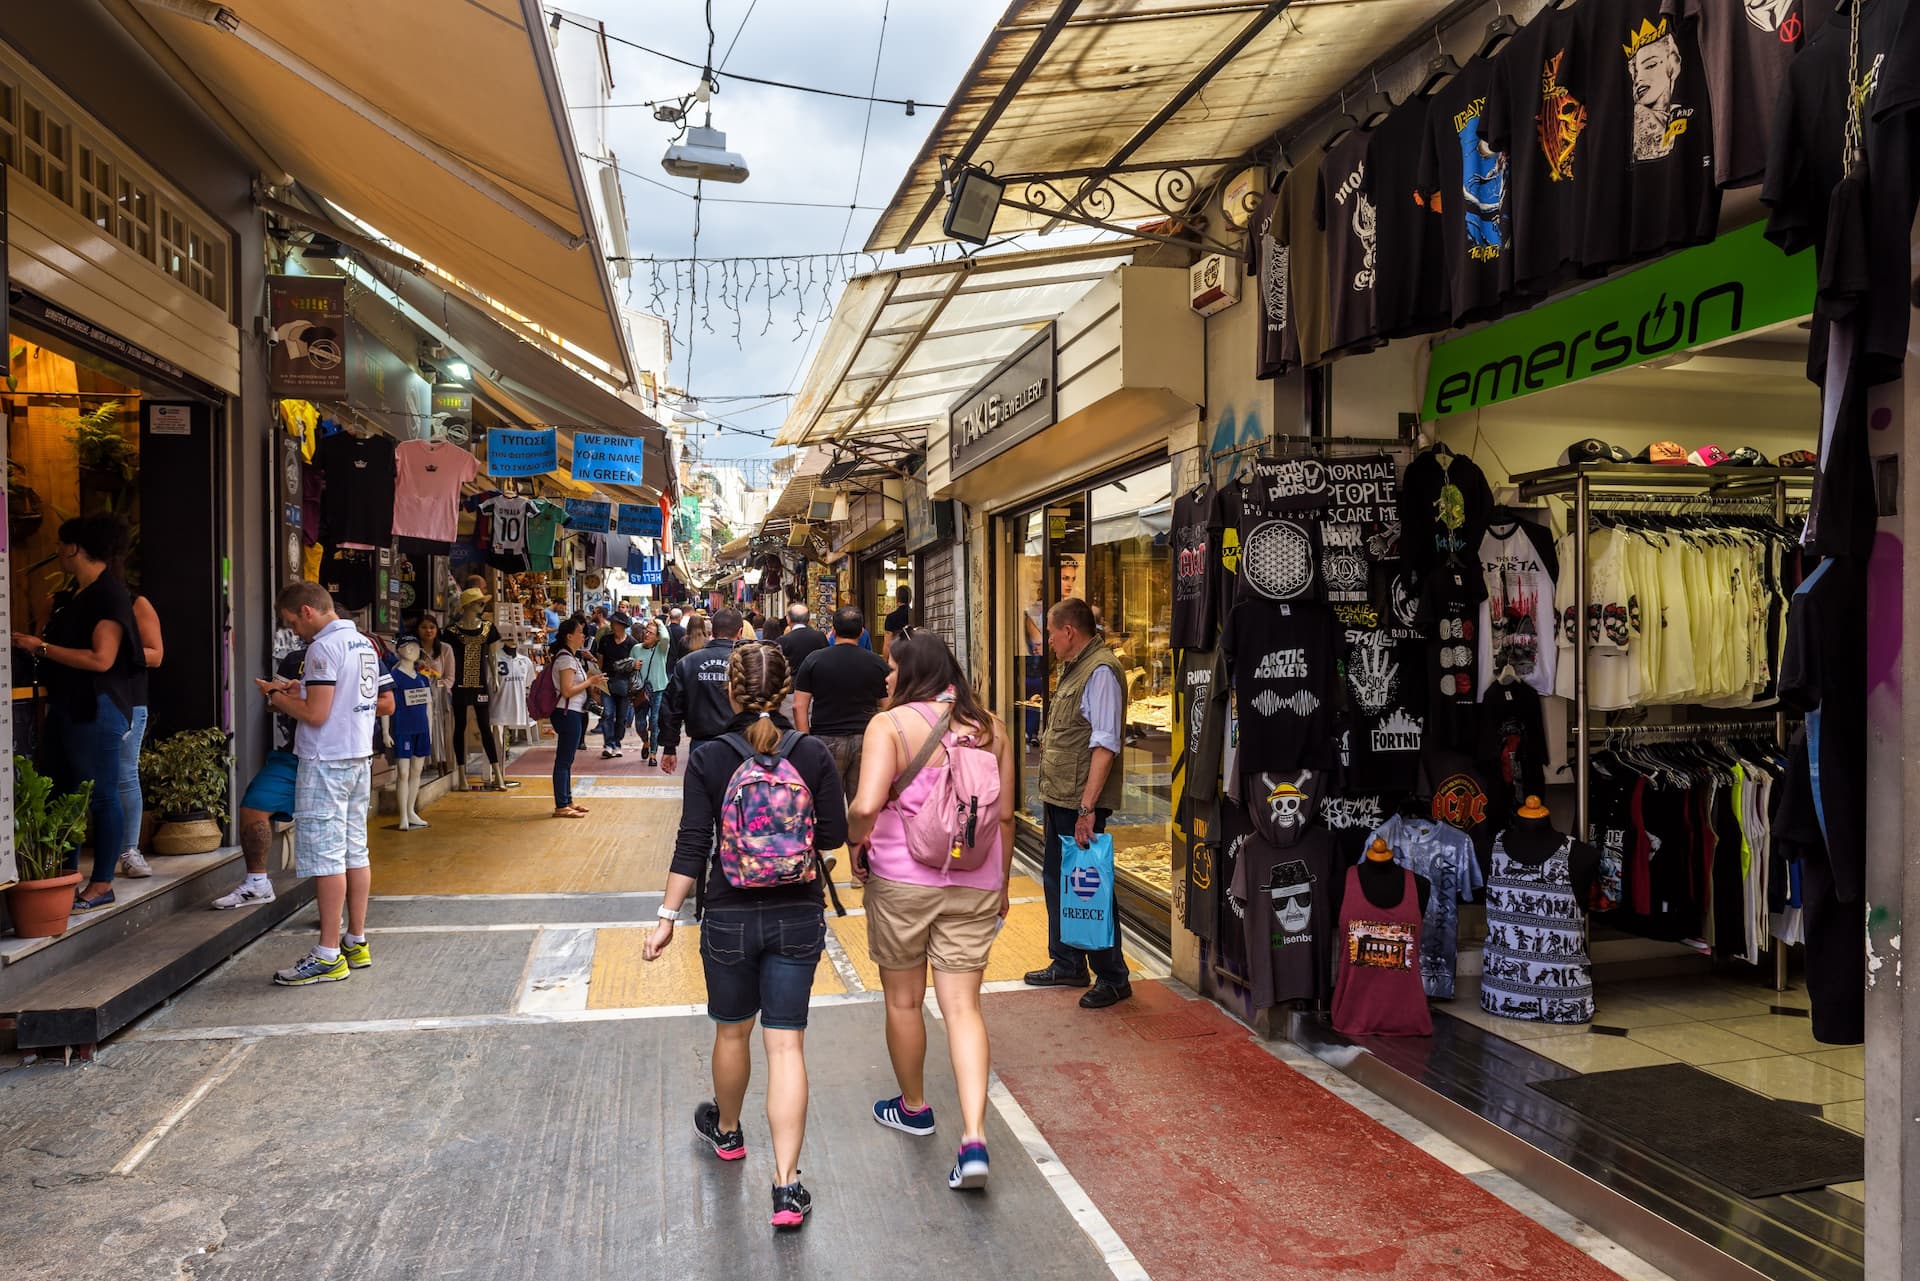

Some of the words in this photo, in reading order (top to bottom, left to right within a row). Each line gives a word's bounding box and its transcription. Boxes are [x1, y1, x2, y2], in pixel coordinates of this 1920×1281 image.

[1436, 281, 1744, 414] emerson
[961, 394, 1000, 447] TAKIS
[1001, 377, 1044, 422] JEWELLERY
[584, 435, 600, 445] WE
[603, 437, 634, 447] PRINT
[576, 450, 605, 461] YOUR
[608, 453, 640, 464] NAME
[579, 469, 590, 478] IN
[593, 468, 635, 481] GREEK
[1257, 460, 1306, 477] twenty
[1277, 472, 1304, 485] one
[1269, 484, 1306, 502] pilots
[1328, 506, 1374, 524] SCARE
[1379, 506, 1400, 522] ME
[500, 516, 520, 542] 10
[1261, 649, 1305, 664] ARCTIC
[360, 652, 378, 699] 5
[1254, 663, 1308, 679] MONKEYS
[1064, 875, 1070, 895] I
[1062, 907, 1104, 920] GREECE
